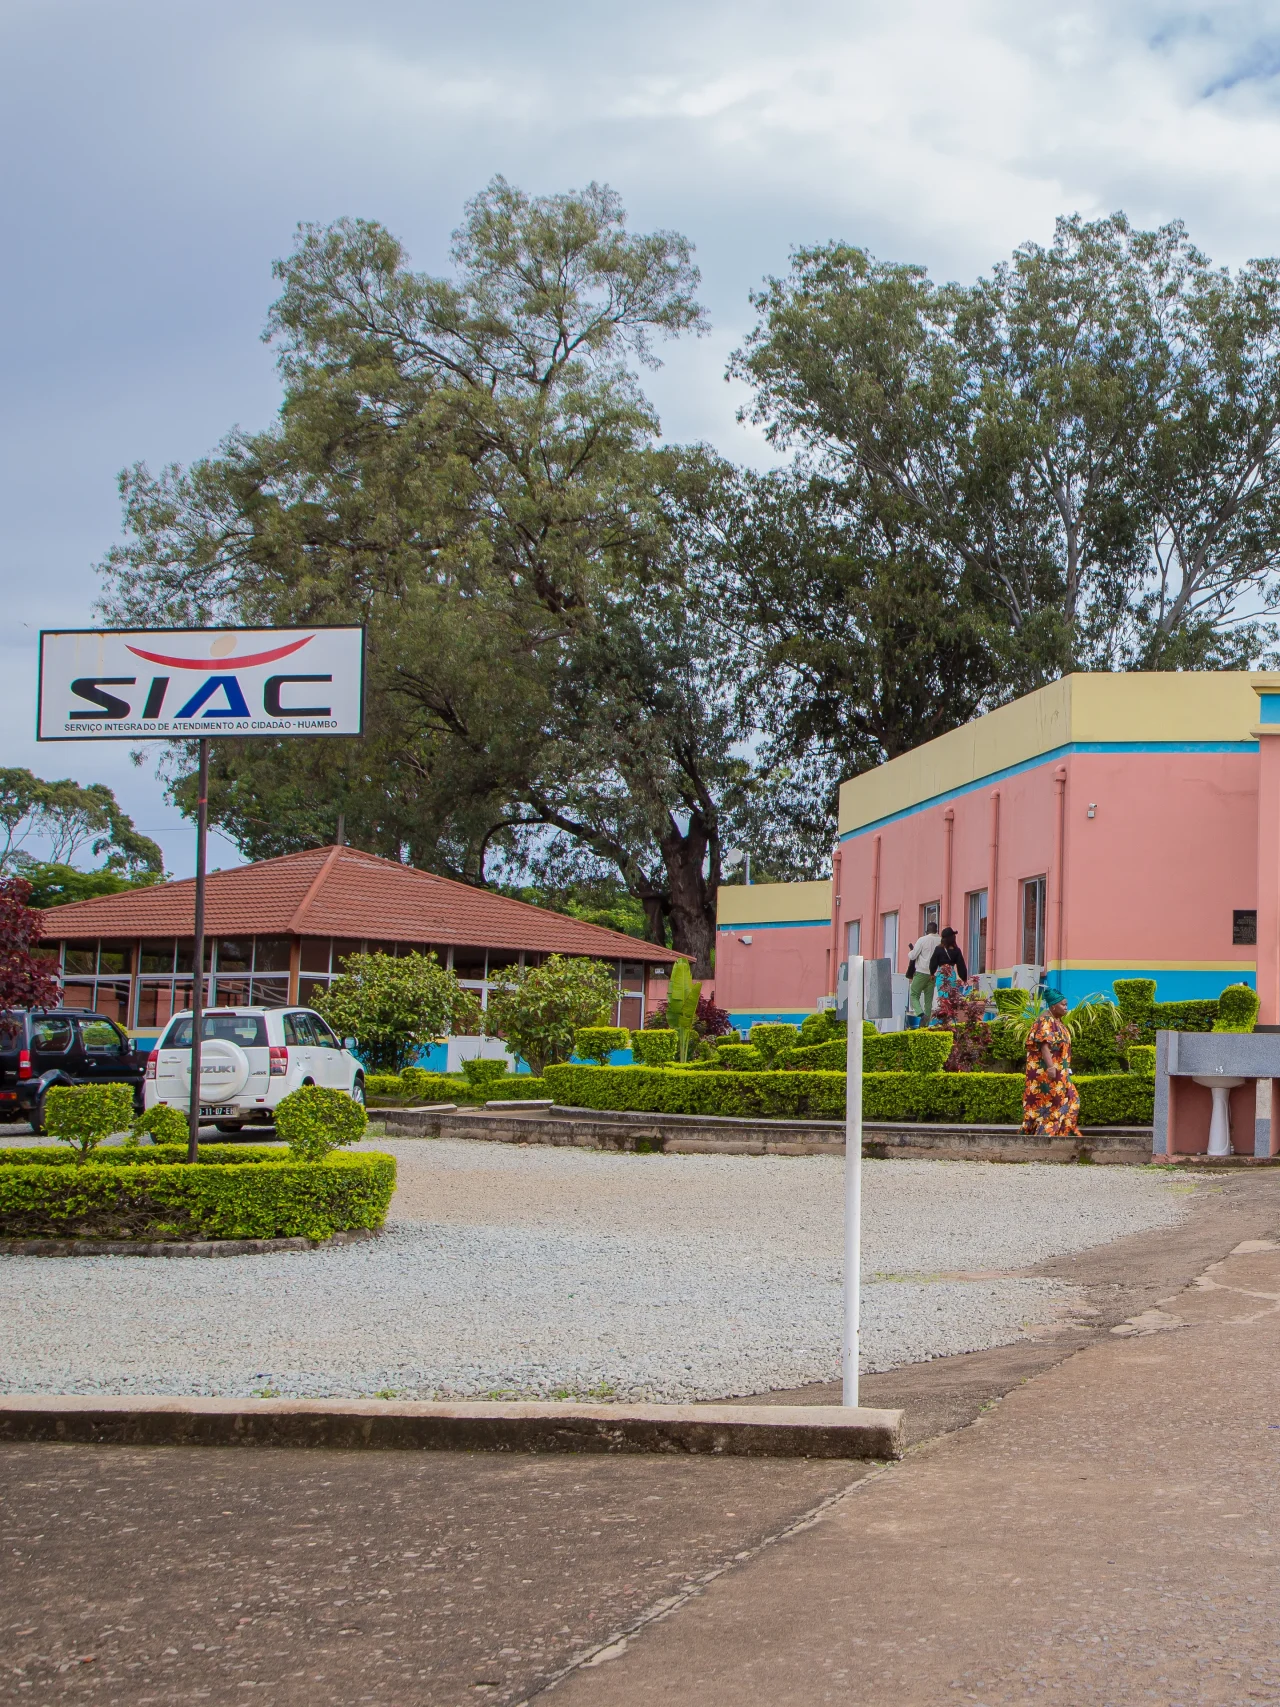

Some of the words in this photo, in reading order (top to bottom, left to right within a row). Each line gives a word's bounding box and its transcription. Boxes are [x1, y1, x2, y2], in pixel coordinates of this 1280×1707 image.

[69, 674, 332, 720] SIAC
[64, 723, 102, 733] SERVIÇO
[104, 722, 157, 731] INTEGRADO
[157, 722, 169, 731] DE
[172, 721, 234, 730] ATENDIMENTO
[236, 721, 249, 729] AO
[251, 719, 291, 729] CIDADÃO
[297, 720, 338, 729] HUAMBO
